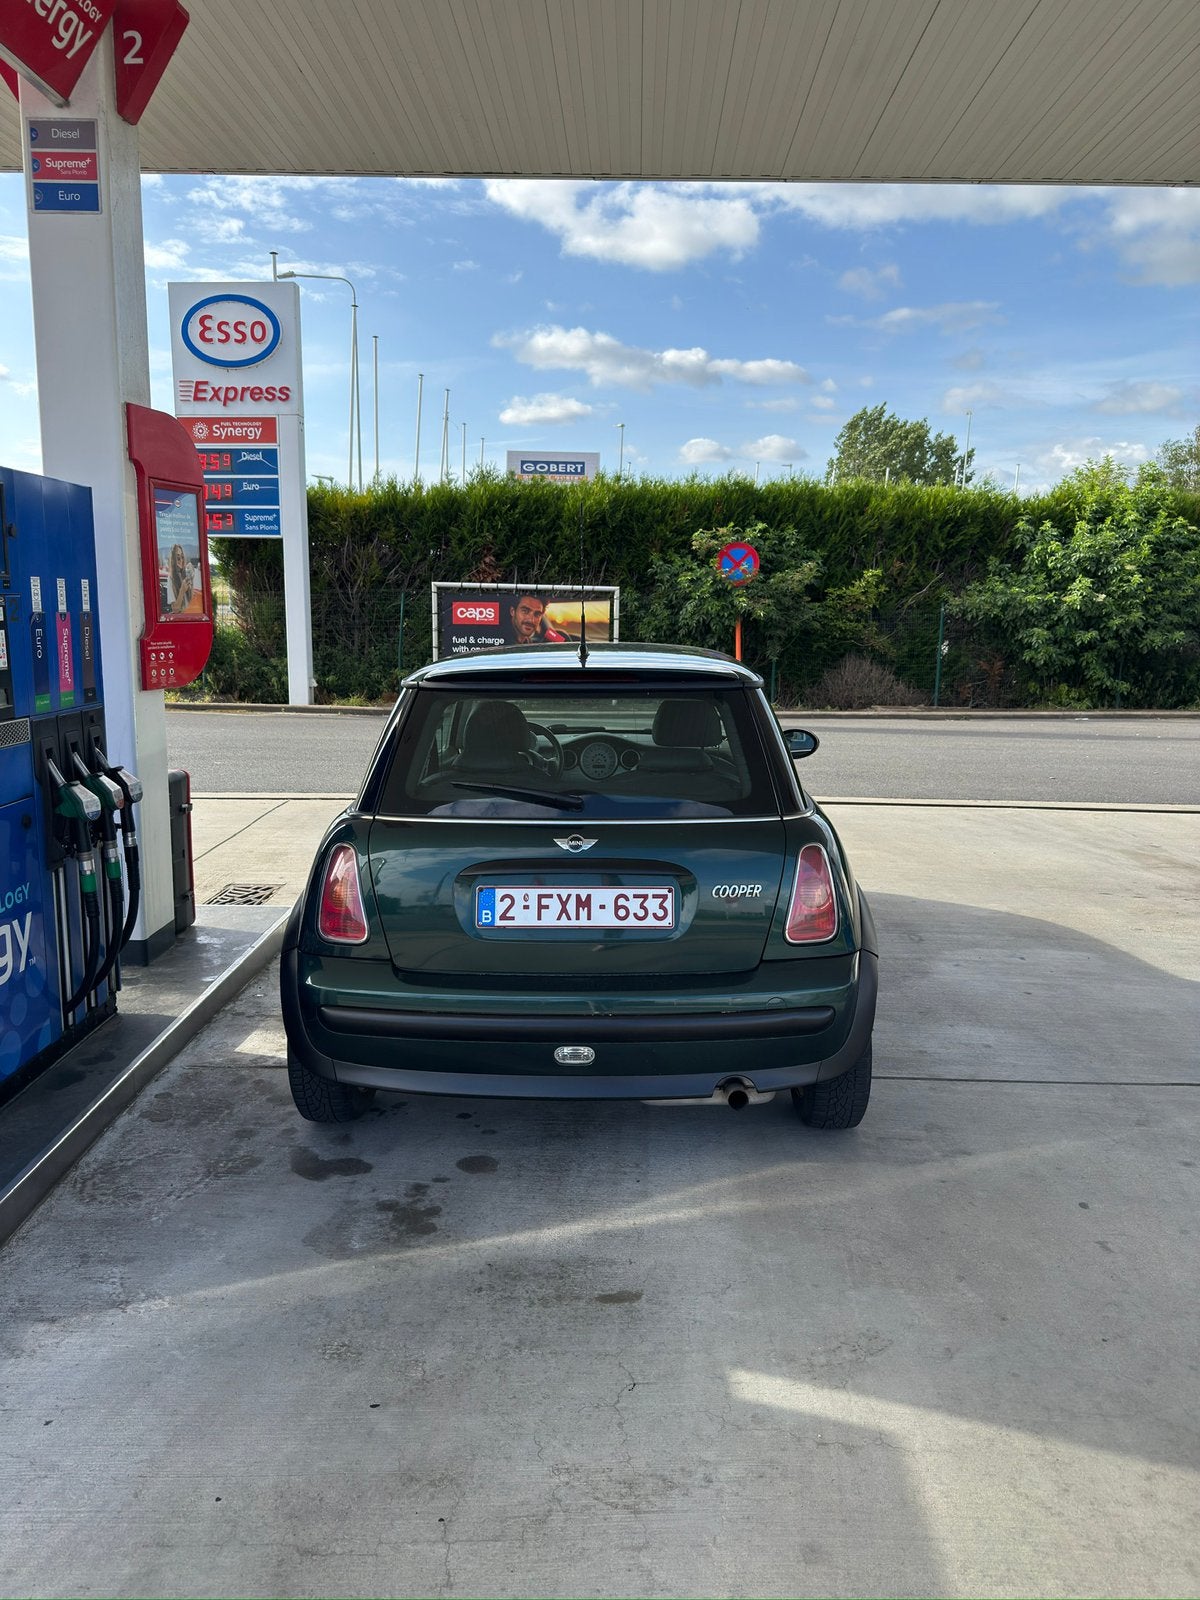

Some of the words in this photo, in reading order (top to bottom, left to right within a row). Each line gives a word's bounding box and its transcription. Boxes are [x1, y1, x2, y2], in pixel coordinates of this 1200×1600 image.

[26, 0, 93, 59] ergy
[122, 30, 144, 65] 2
[51, 128, 80, 139] Diesel
[45, 157, 92, 171] Supreme+
[58, 190, 81, 201] Euro
[193, 380, 291, 407] Express
[212, 424, 263, 440] Synergy
[241, 451, 262, 460] Diesel
[522, 463, 583, 473] GOBERT
[243, 482, 260, 490] Euro
[244, 513, 277, 522] Supreme+
[457, 607, 495, 621] caps
[35, 628, 43, 659] Euro
[452, 636, 467, 644] fuel
[468, 636, 476, 644] &
[477, 636, 505, 646] charge
[452, 645, 469, 653] with
[62, 628, 72, 684] Supreme+
[711, 884, 762, 899] COOPER
[482, 910, 492, 923] B
